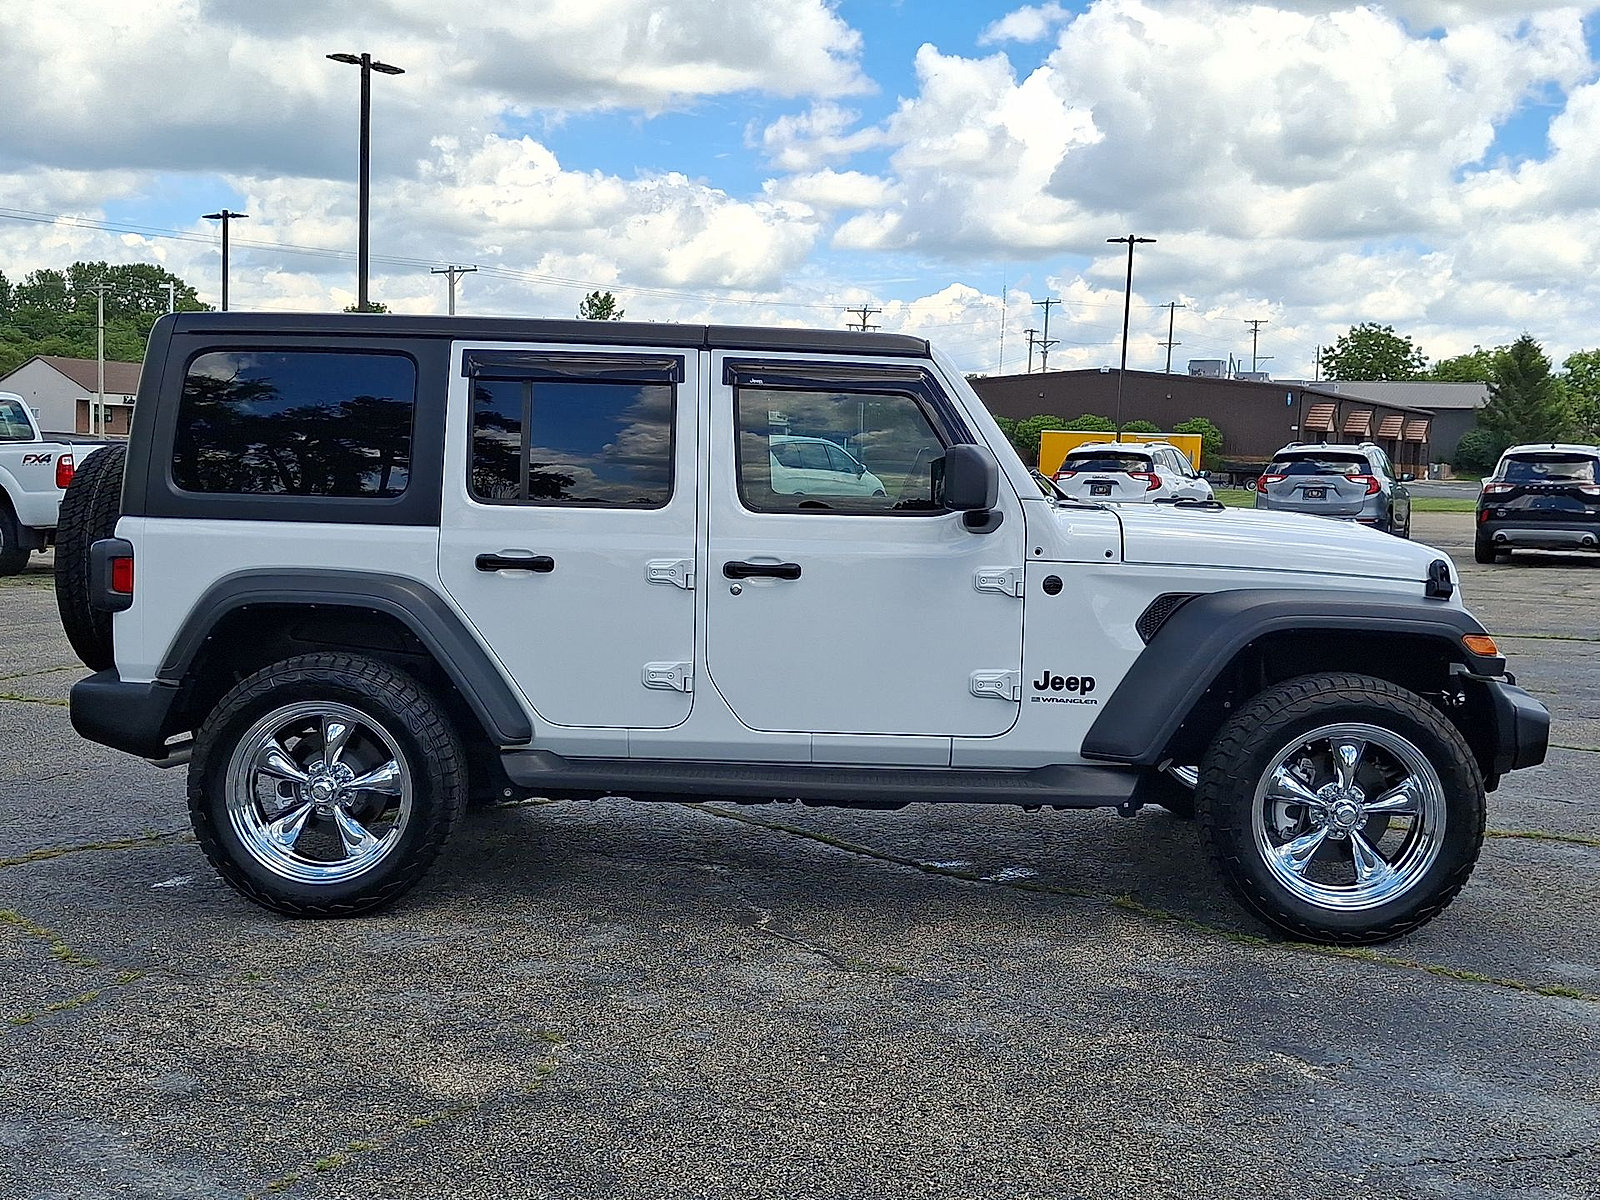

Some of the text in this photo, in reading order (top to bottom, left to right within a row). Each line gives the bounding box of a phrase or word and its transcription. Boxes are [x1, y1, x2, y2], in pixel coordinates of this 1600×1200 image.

[22, 453, 53, 464] FX4
[1033, 670, 1096, 696] Jeep
[1041, 697, 1098, 705] WRANGLER
